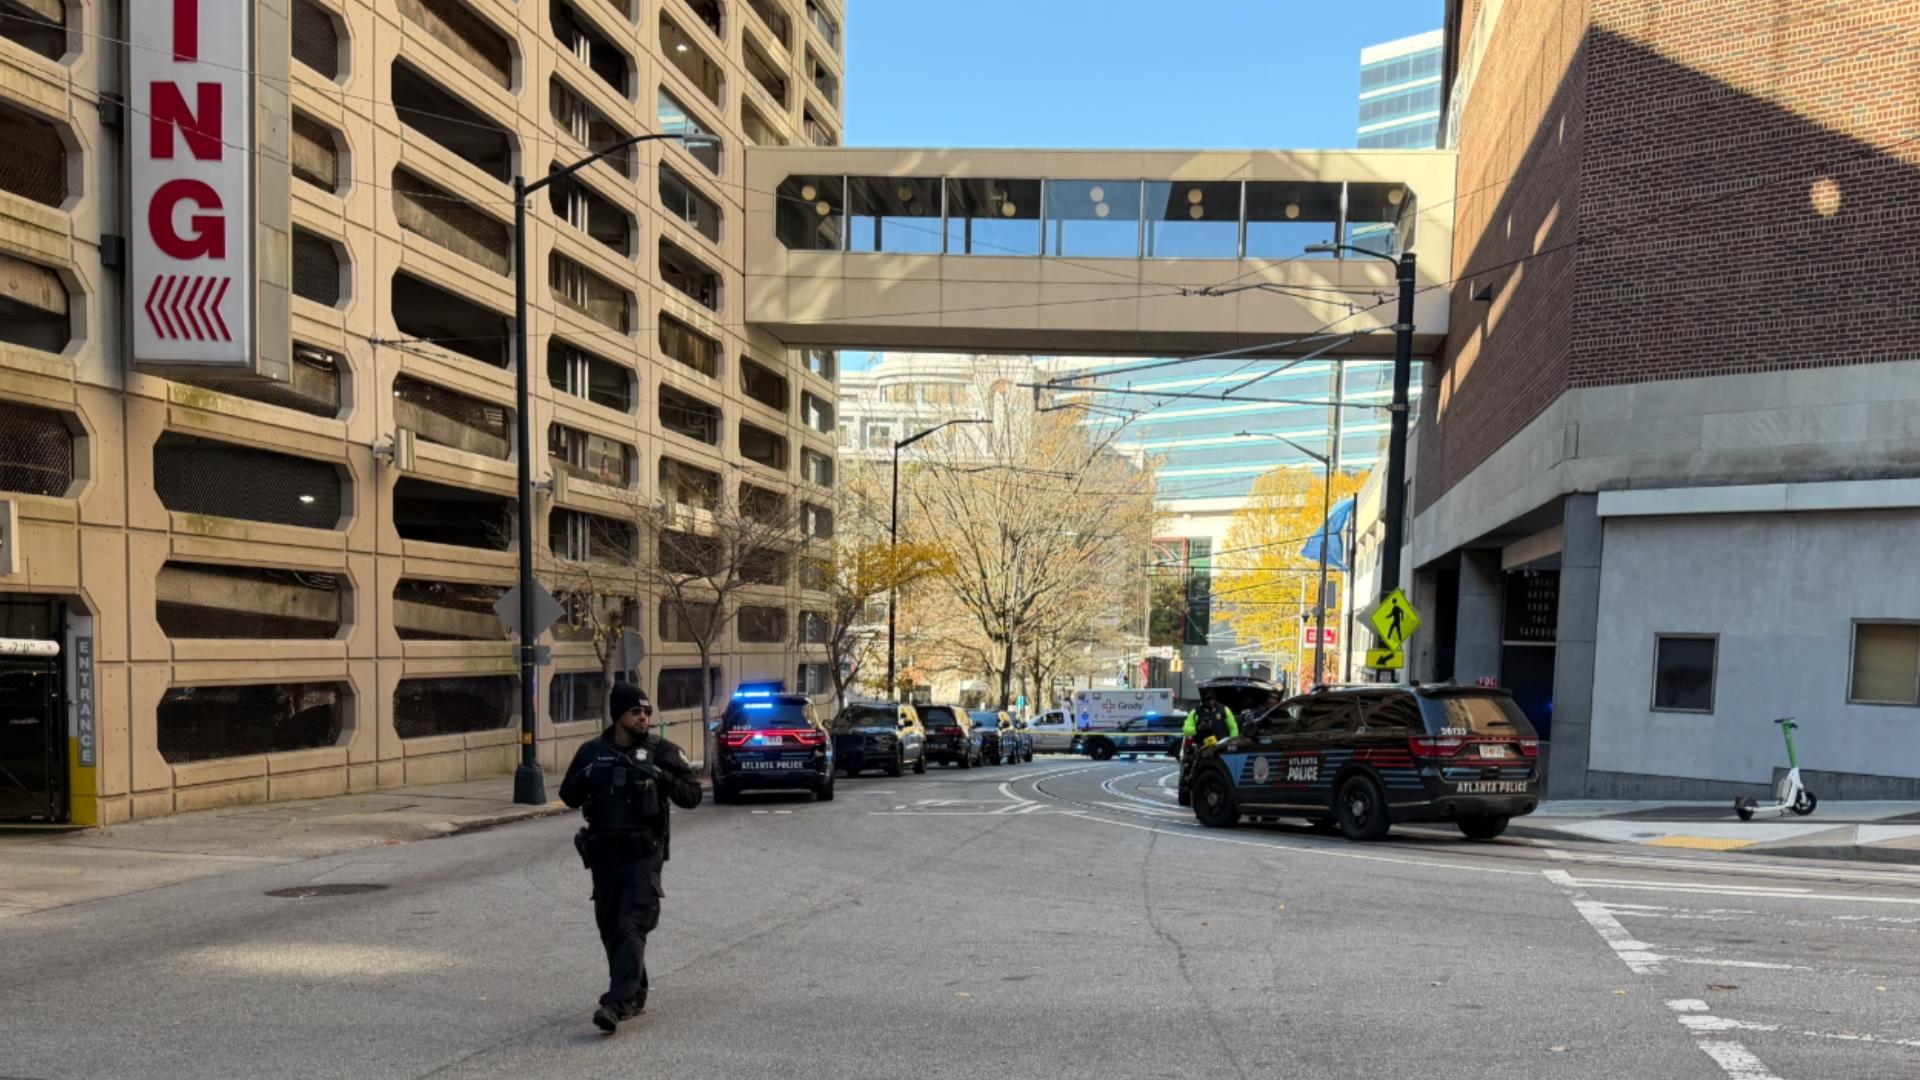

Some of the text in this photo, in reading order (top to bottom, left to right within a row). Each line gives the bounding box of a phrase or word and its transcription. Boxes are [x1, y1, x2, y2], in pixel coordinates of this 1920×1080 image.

[79, 641, 92, 762] ENTRANCE
[1118, 701, 1144, 711] Grady
[741, 761, 803, 769] ATLANTA POLICE
[1289, 757, 1318, 765] ATLANTA
[1287, 766, 1318, 781] POLICE
[1456, 782, 1528, 793] ATLANTA POLICE
